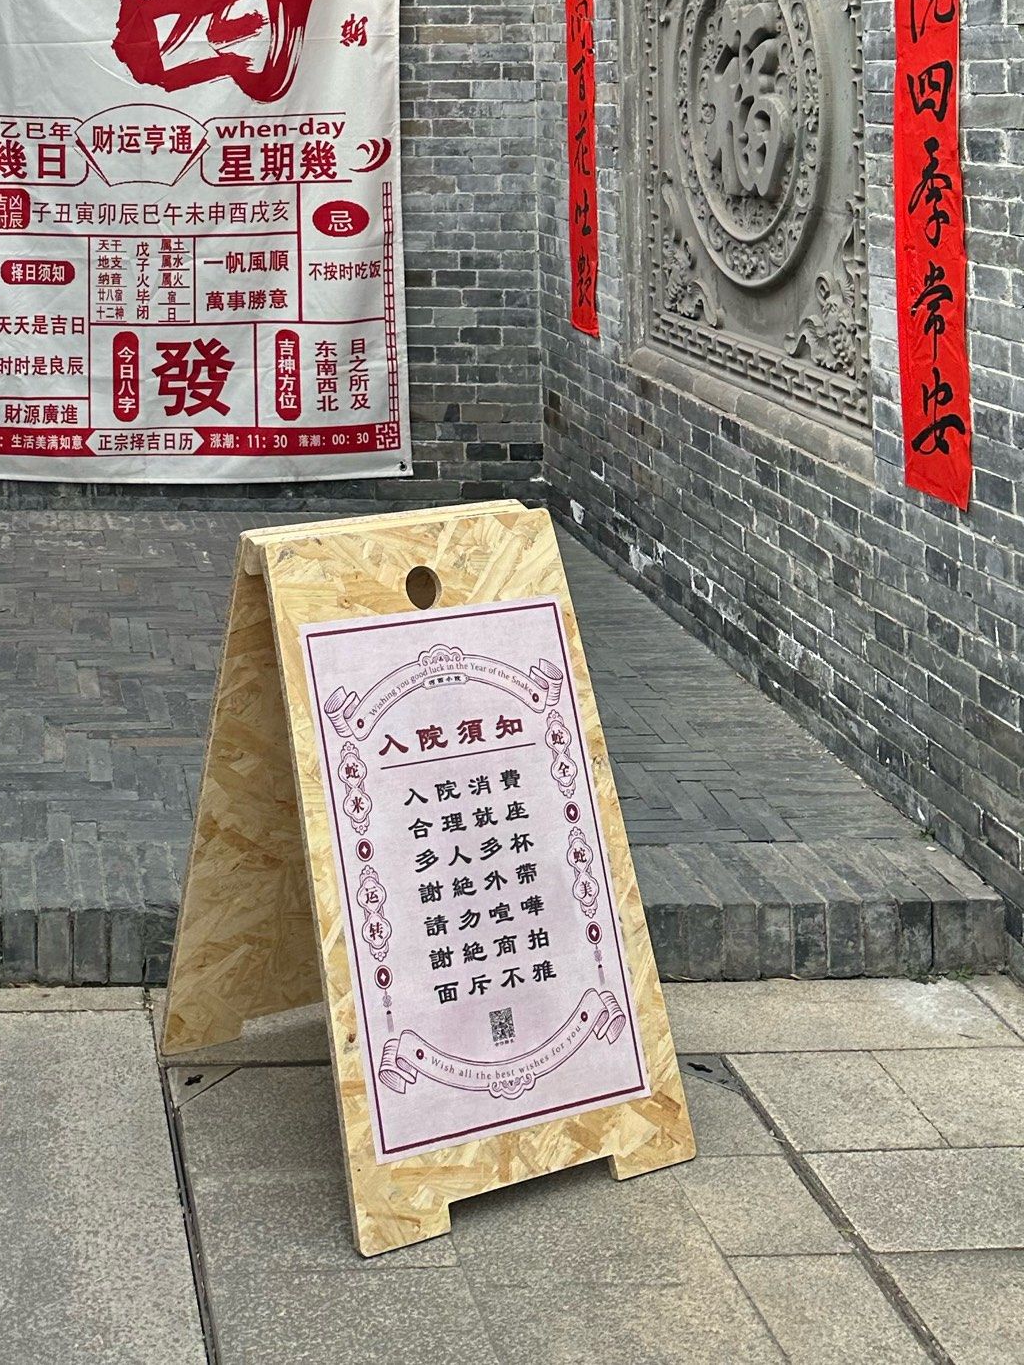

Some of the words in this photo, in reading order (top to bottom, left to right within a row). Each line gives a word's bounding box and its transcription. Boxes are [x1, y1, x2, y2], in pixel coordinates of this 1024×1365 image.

[92, 124, 194, 155] 财运亨通
[215, 118, 346, 140] when-day
[32, 200, 290, 226] 子丑寅卯辰巳午未申酉戌亥
[328, 211, 353, 231] 忌
[99, 240, 122, 250] 天干
[161, 239, 184, 251] 属土
[98, 256, 122, 268] 地支
[161, 255, 183, 267] 属水
[203, 250, 289, 273] 一帆風順
[309, 260, 381, 281] 不按时吃饭
[12, 263, 64, 282] 择日须知
[98, 273, 122, 285] 纳音
[162, 273, 183, 285] 属火
[98, 289, 122, 301] 廿八宿
[168, 291, 176, 303] 宿
[206, 289, 288, 311] 萬事勝意
[97, 307, 124, 319] 十二神
[168, 308, 175, 321] 日
[118, 347, 135, 413] 今日八字
[152, 338, 235, 416] 發
[278, 339, 297, 409] 吉神方位
[315, 341, 338, 412] 东南西北
[349, 338, 370, 410] 目之所及
[5, 405, 78, 424] 財源廣進
[98, 431, 194, 451] 正宗择吉日历
[369, 689, 398, 716] Wishing
[397, 679, 410, 693] you
[411, 669, 428, 683] good
[429, 665, 445, 674] luck
[470, 663, 487, 672] Year
[497, 669, 510, 680] the
[404, 769, 523, 808] 入院消費
[408, 801, 529, 839] 合理就座
[415, 833, 534, 873] 多人多杯
[434, 960, 556, 1004] 面斥不雅
[431, 1056, 455, 1074] Wish
[459, 1070, 472, 1078] all
[495, 1070, 515, 1078] best
[552, 1042, 565, 1056] for
[567, 1025, 581, 1044] you
